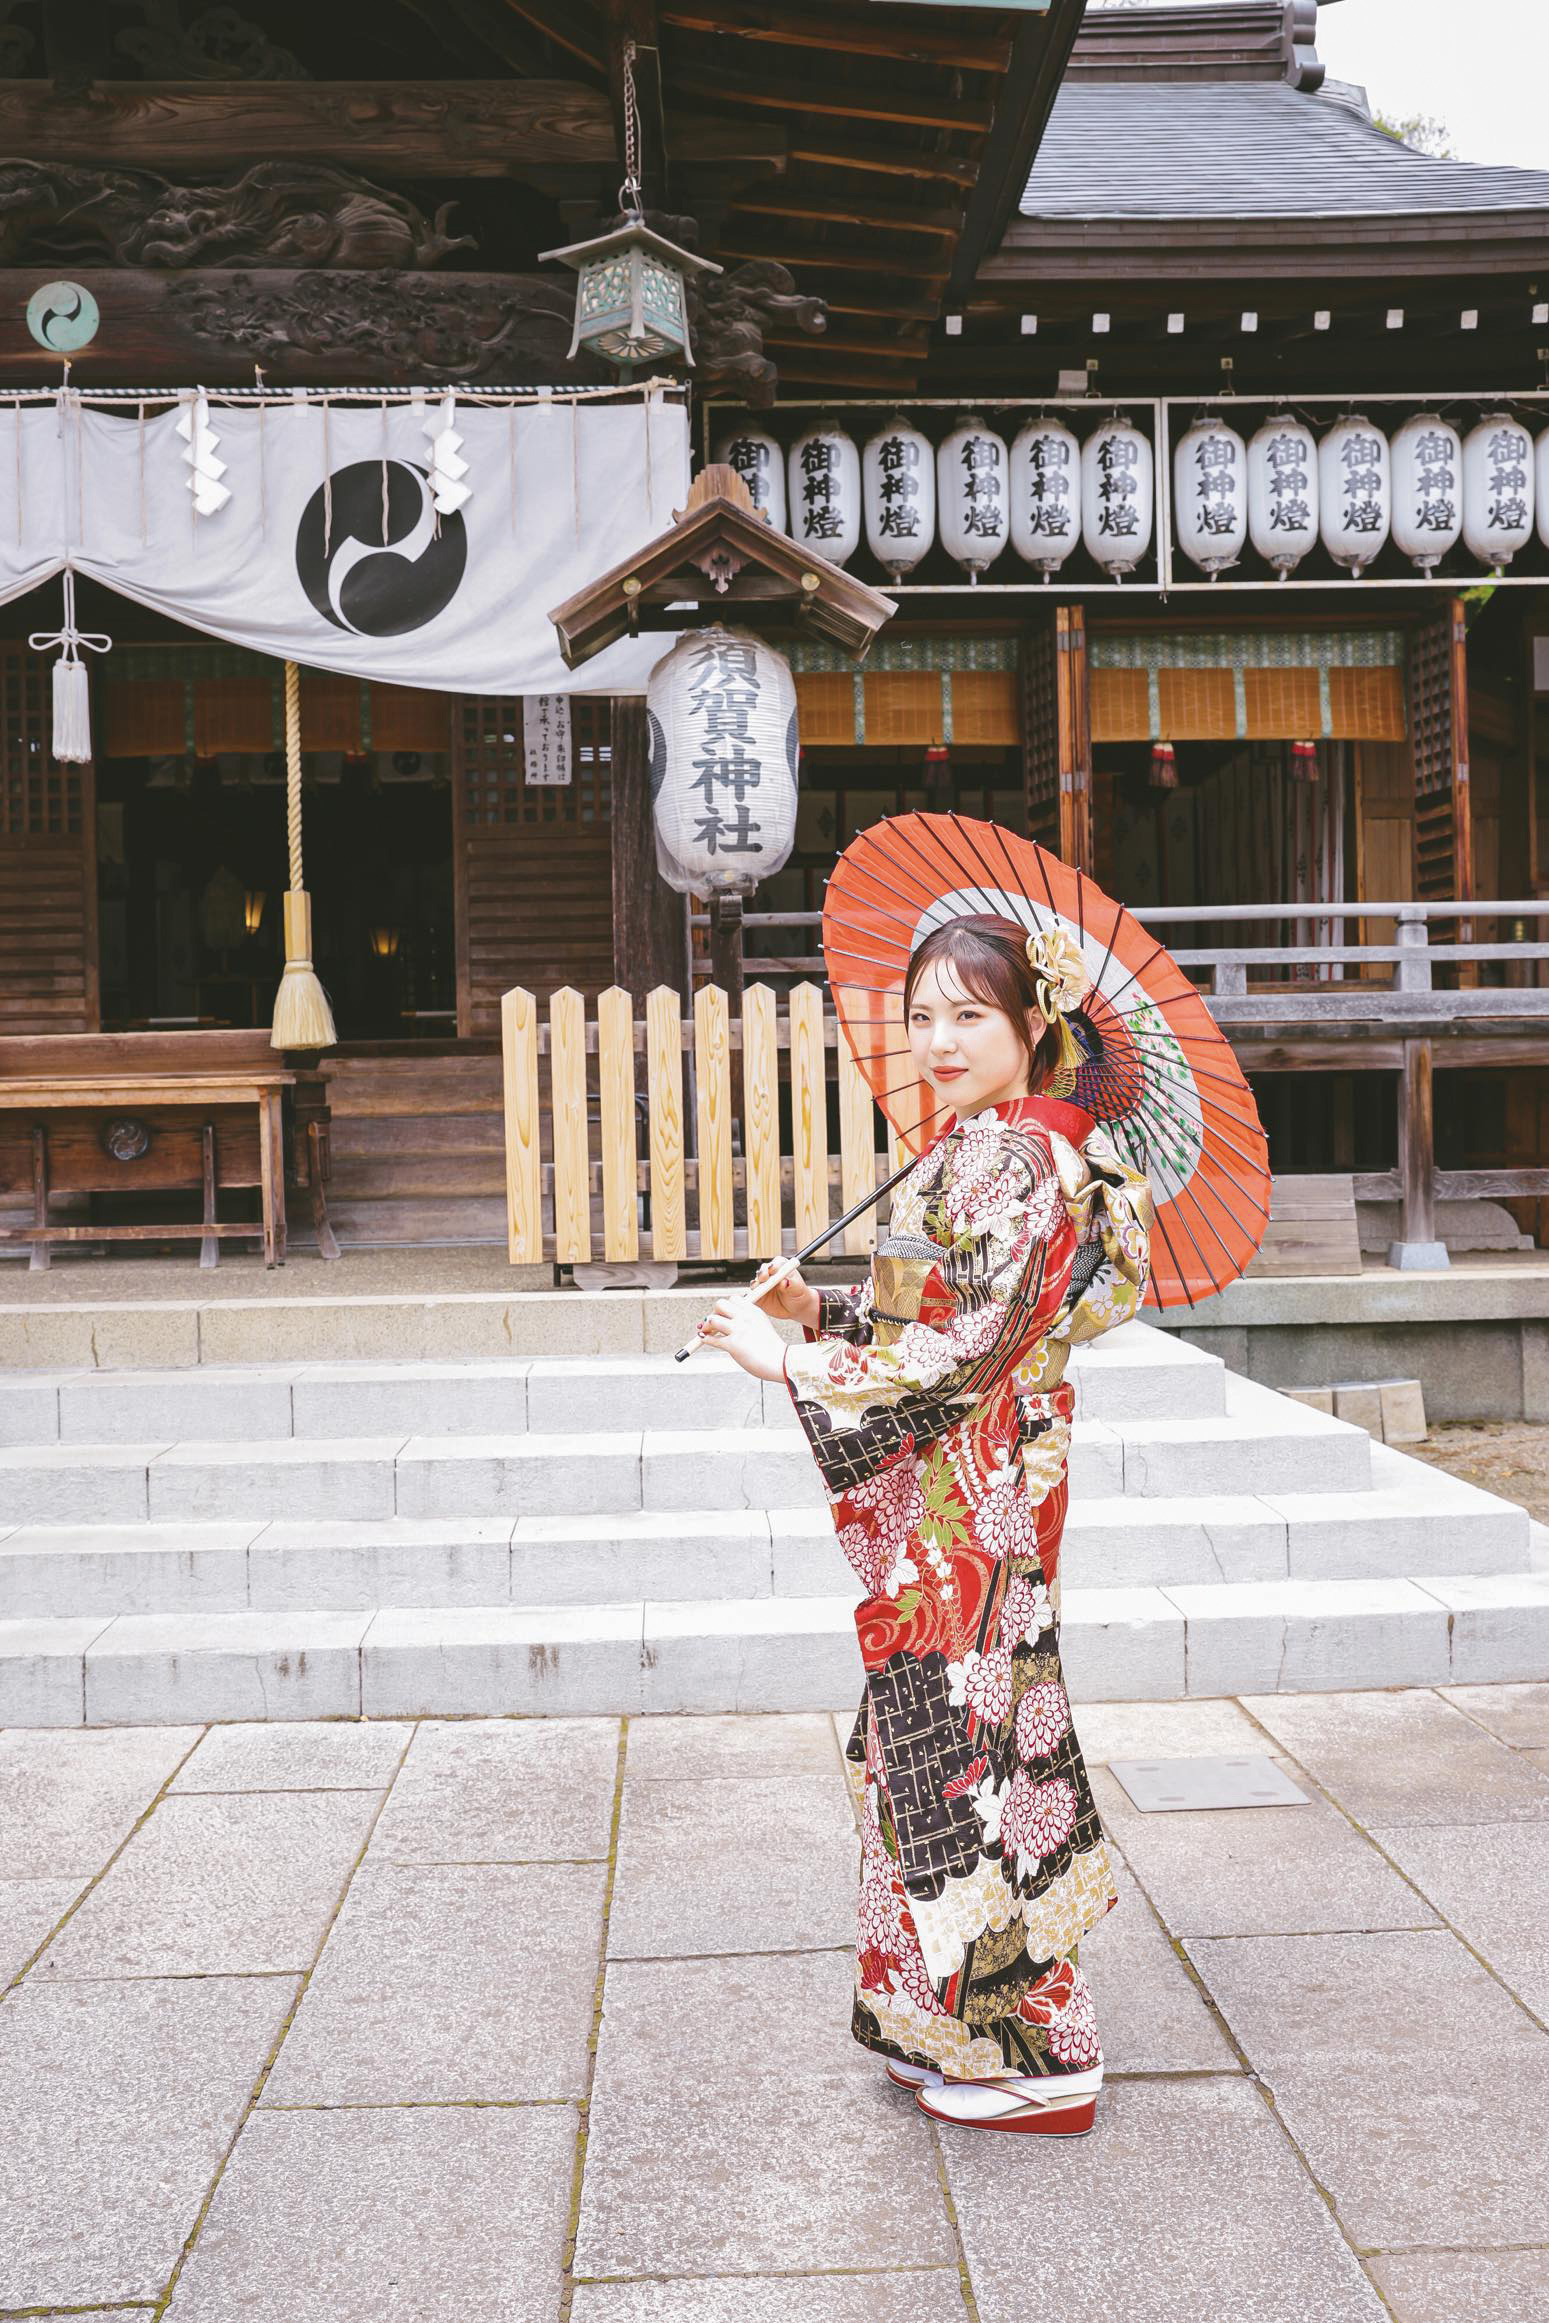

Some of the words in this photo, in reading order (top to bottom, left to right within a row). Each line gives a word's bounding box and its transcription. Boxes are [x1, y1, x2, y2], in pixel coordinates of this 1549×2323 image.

[800, 437, 844, 540] 御神燈
[877, 435, 920, 538] 御神燈
[961, 435, 1002, 538] 御神燈
[1029, 434, 1071, 537] 御神燈
[1096, 433, 1140, 537] 御神燈
[1196, 435, 1237, 535] 御神燈
[1267, 433, 1311, 532] 御神燈
[1341, 433, 1383, 533] 御神燈
[1415, 430, 1455, 531] 御神燈
[1487, 429, 1528, 531] 御神燈
[688, 641, 763, 856] 須賀神社
